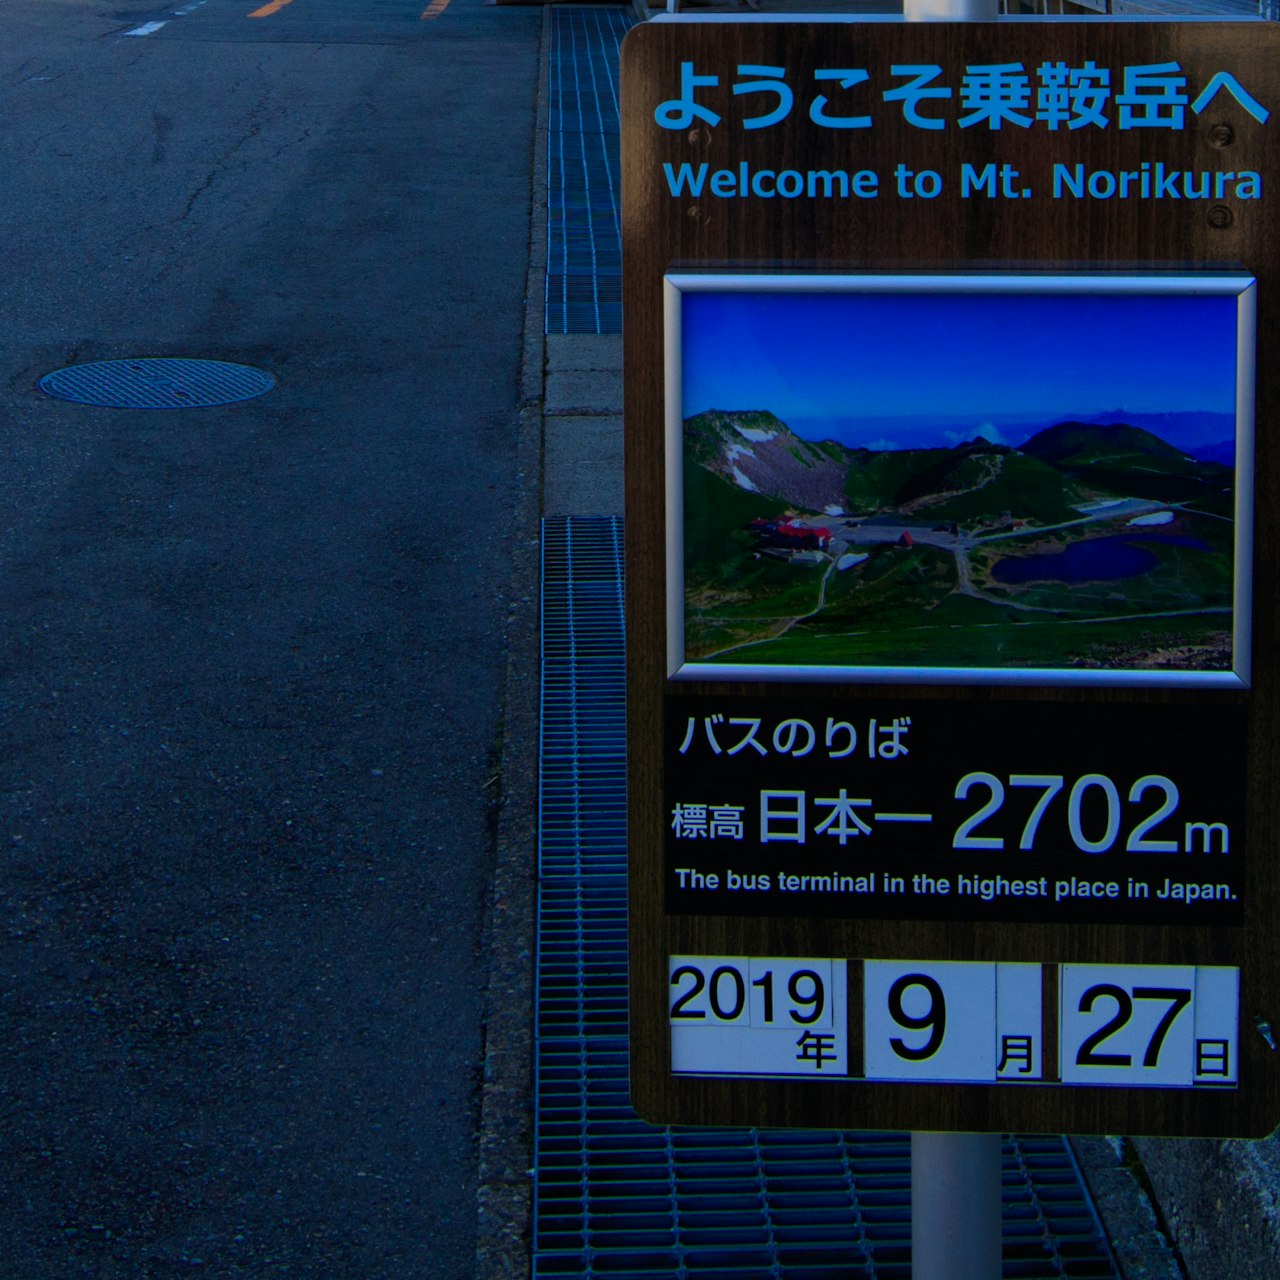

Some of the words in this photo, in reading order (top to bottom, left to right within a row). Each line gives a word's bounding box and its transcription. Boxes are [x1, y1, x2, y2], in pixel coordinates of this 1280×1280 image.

[654, 60, 1270, 131] ようこそ乗鞍岳へ
[663, 161, 879, 199] Welcome
[895, 164, 942, 199] to
[960, 163, 1032, 199] Mt.
[1053, 162, 1262, 200] Norikura
[678, 714, 913, 758] バスのりば
[671, 803, 745, 840] 標高
[759, 788, 933, 844] 日本一
[676, 869, 718, 889] The
[727, 870, 770, 890] bus
[778, 870, 875, 893] terminal
[883, 872, 905, 894] in
[912, 873, 950, 895] the
[958, 874, 1047, 900] highest
[1055, 877, 1119, 901] place
[1128, 877, 1149, 898] in
[1156, 878, 1237, 904] Japan.
[670, 965, 824, 1024] 2019
[796, 1031, 837, 1069] 年
[888, 973, 946, 1061] 9
[997, 1035, 1032, 1073] 月
[1075, 984, 1191, 1067] 27
[1196, 1039, 1229, 1078] 日
